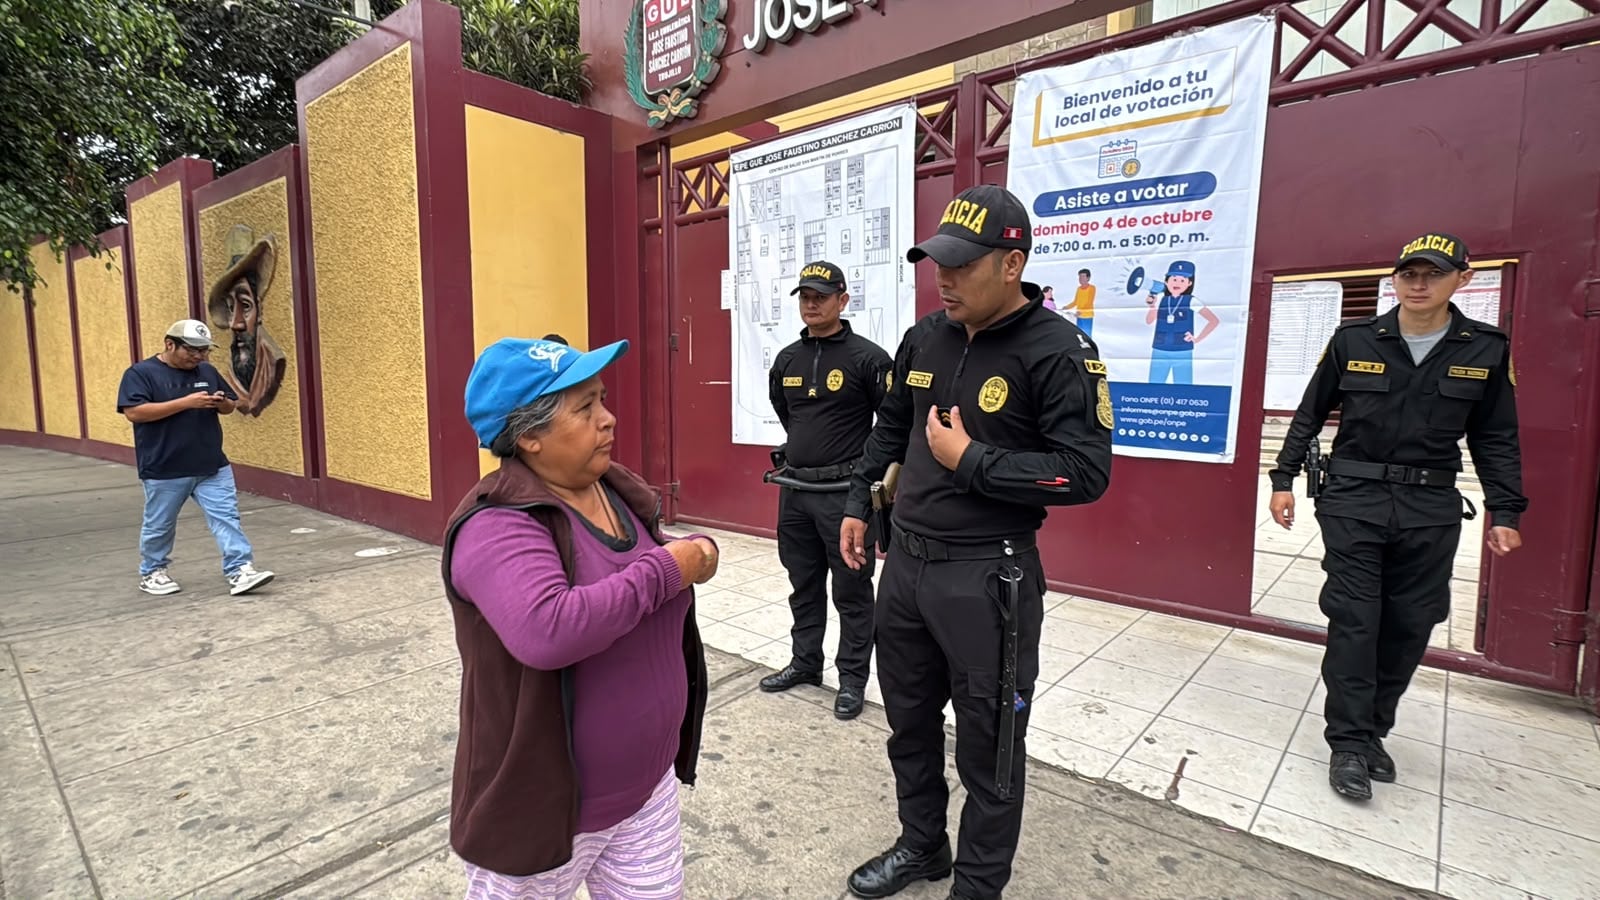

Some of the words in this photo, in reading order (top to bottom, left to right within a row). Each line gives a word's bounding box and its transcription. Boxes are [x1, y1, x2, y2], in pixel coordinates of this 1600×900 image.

[664, 27, 688, 51] FAUSTINO
[658, 65, 682, 82] TRUJILLO
[1063, 79, 1165, 110] Bienvenido
[1168, 75, 1182, 88] a
[1186, 69, 1208, 84] tu
[1055, 108, 1096, 128] local
[1099, 104, 1122, 119] de
[1126, 86, 1214, 114] votación
[749, 157, 763, 168] GUE
[764, 152, 782, 164] JOSE
[783, 141, 820, 158] FAUSTINO
[820, 130, 859, 148] SANCHEZ
[860, 119, 900, 137] CARRION
[1054, 191, 1111, 211] Asiste
[1114, 190, 1128, 203] a
[1132, 182, 1189, 201] votar
[938, 198, 988, 235] LICIA
[1032, 220, 1100, 237] domingo
[1102, 216, 1114, 230] 4
[1116, 215, 1138, 229] de
[1141, 209, 1213, 226] octubre
[1034, 243, 1050, 255] de
[1052, 240, 1080, 253] 7:00
[1082, 239, 1095, 251] a.
[1098, 238, 1117, 249] m.
[1119, 237, 1130, 248] a
[1133, 232, 1166, 247] 5:00
[1169, 233, 1185, 248] p.
[1188, 231, 1210, 243] m.
[1400, 235, 1455, 259] POLICIA
[1121, 395, 1139, 403] Fono
[1140, 396, 1159, 404] ONPE
[1160, 396, 1174, 406] (01)
[1120, 416, 1187, 427] www.gob.pe/onpe
